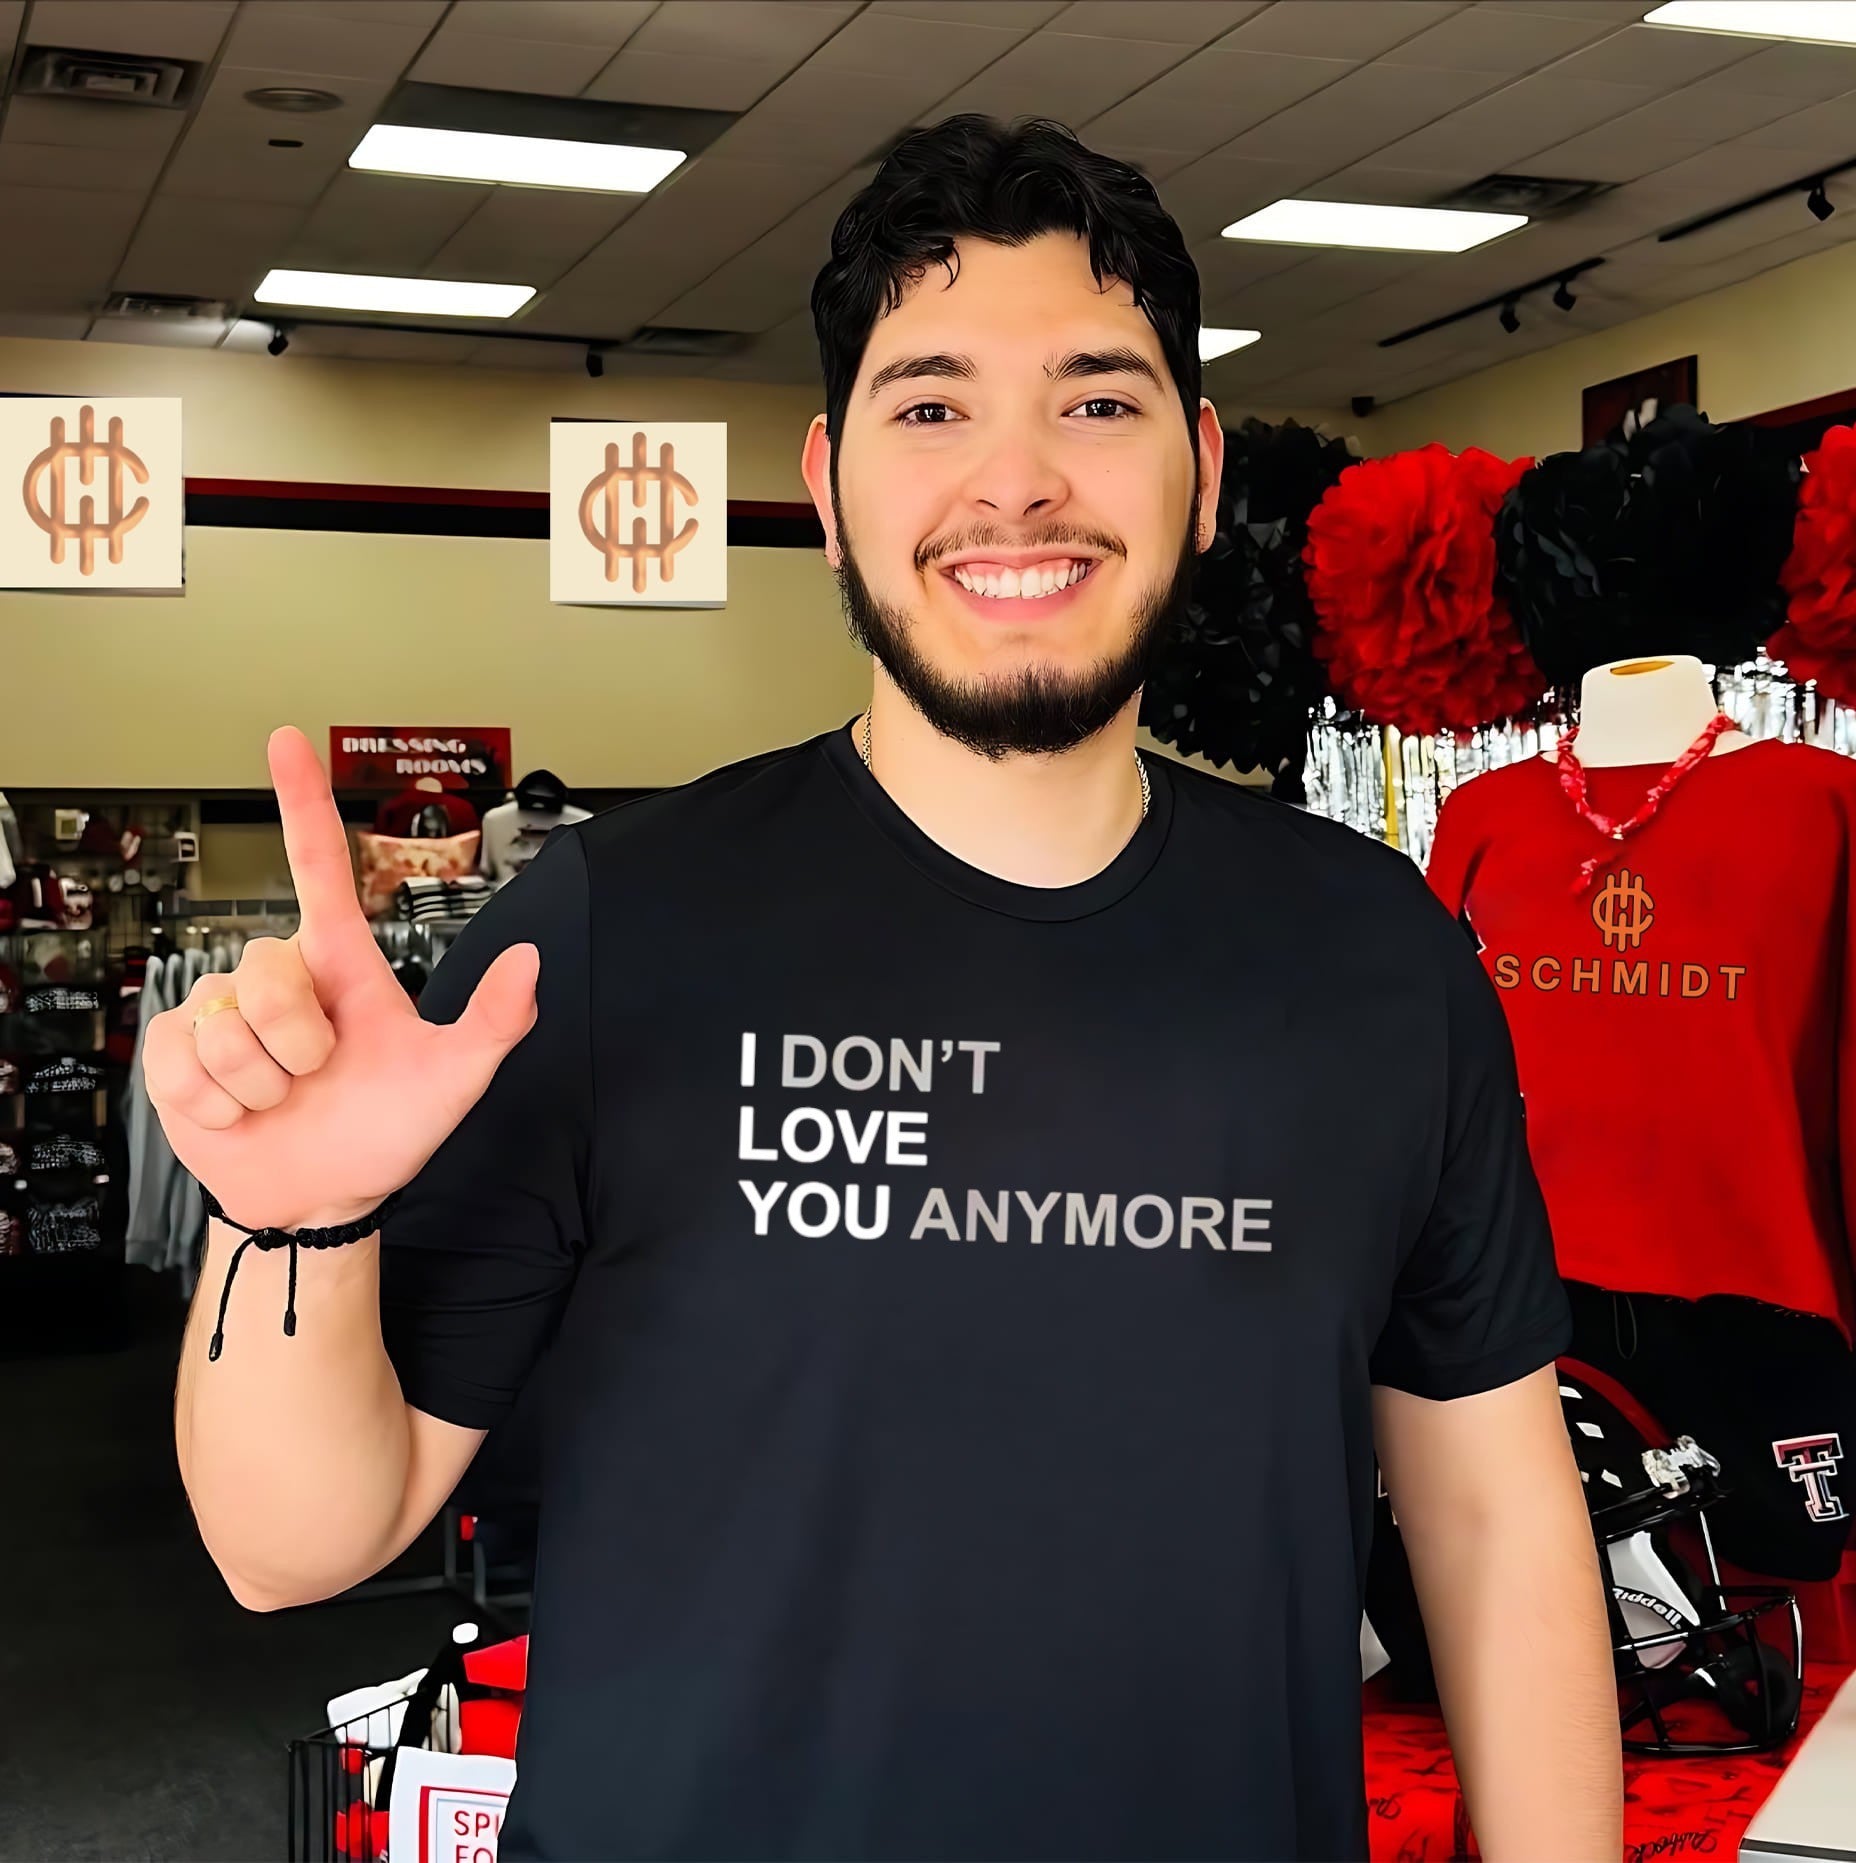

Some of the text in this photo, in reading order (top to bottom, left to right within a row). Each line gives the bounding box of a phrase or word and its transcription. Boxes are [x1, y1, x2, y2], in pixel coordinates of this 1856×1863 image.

[342, 737, 467, 754] DRESSING
[396, 759, 487, 775] ROOMS
[1493, 953, 1747, 1001] SCHMIDT
[740, 1031, 757, 1088] I
[738, 1105, 929, 1167] LOVE
[737, 1179, 1273, 1252] YOU ANYMORE
